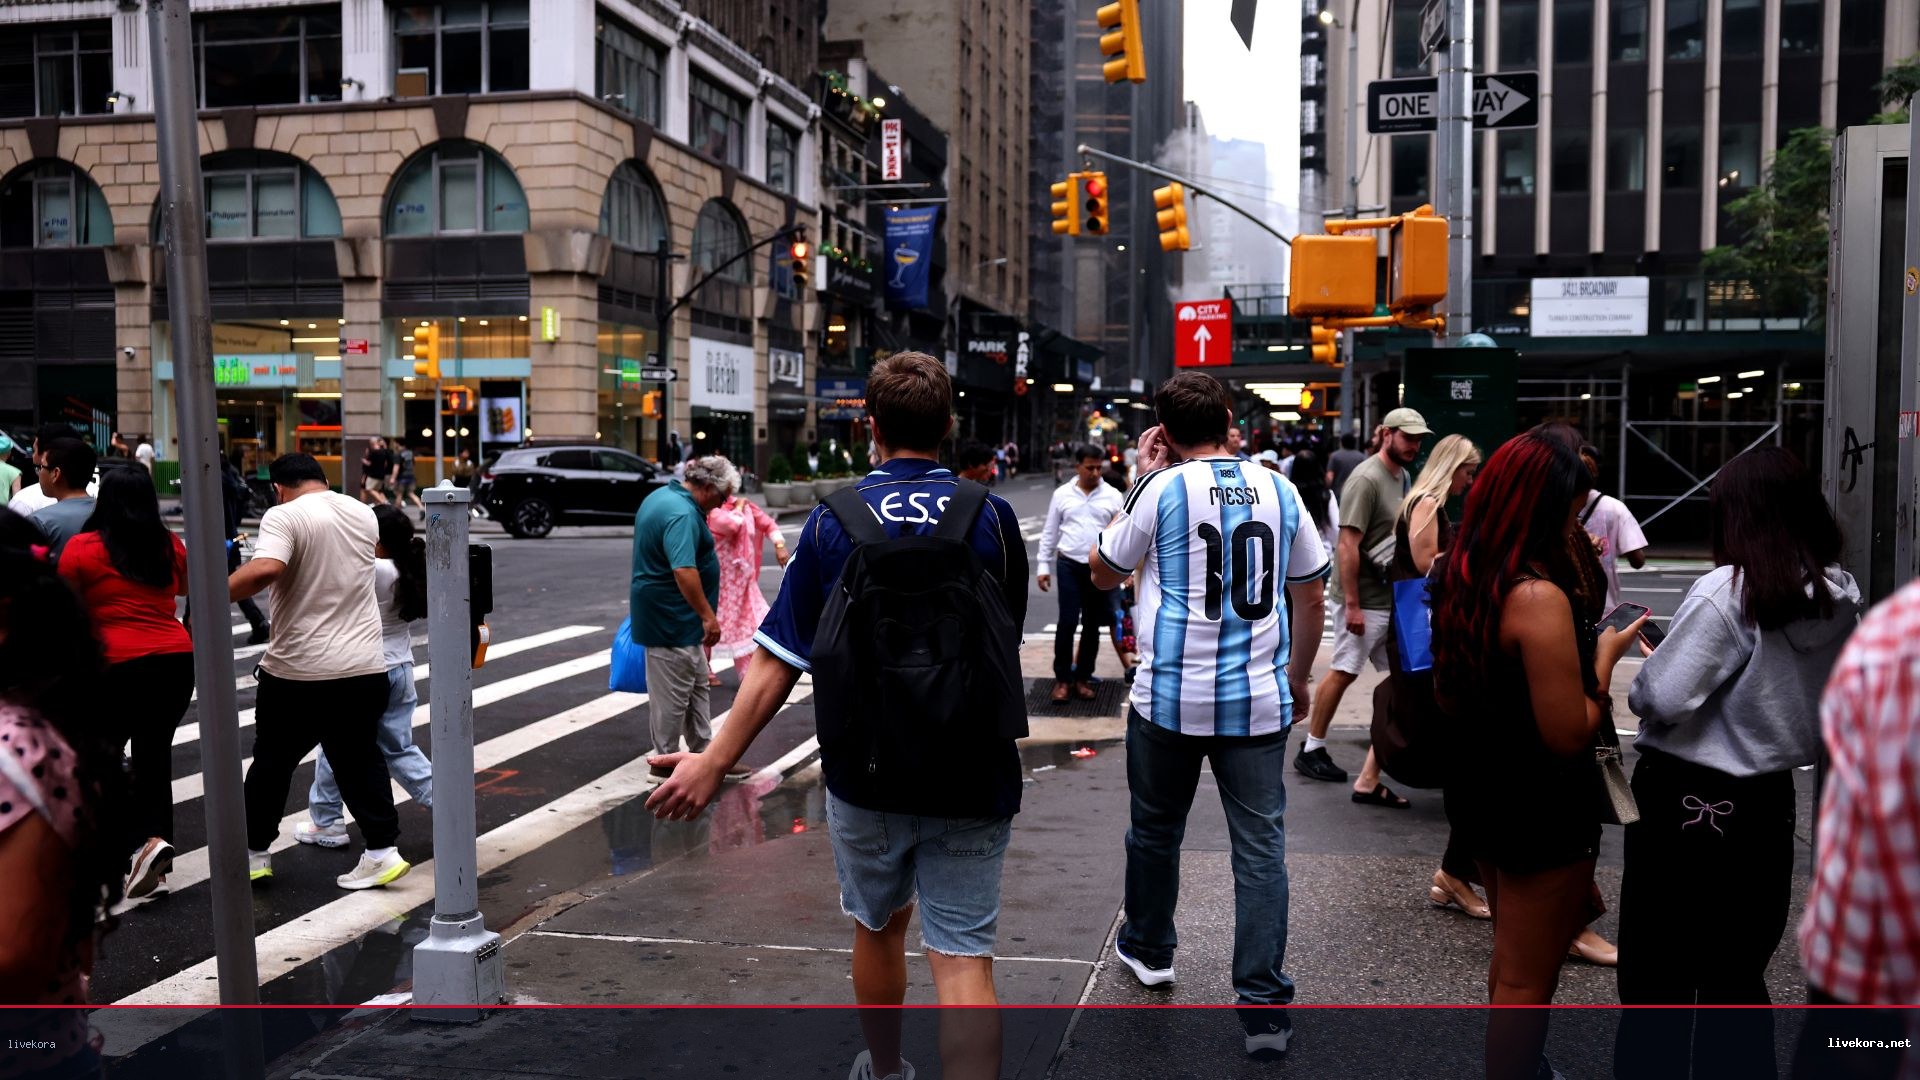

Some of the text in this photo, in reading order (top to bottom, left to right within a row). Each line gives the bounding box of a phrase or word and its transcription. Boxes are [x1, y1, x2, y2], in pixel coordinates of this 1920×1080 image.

[1385, 90, 1509, 117] ONE AY
[1579, 280, 1619, 296] BROADWAY
[1197, 304, 1221, 315] CITY
[1197, 312, 1228, 320] PARKING
[968, 341, 1007, 352] PARK
[1015, 332, 1030, 377] PARK
[1219, 469, 1236, 479] 1893
[1209, 486, 1260, 506] MESSI
[1197, 520, 1275, 622] 10
